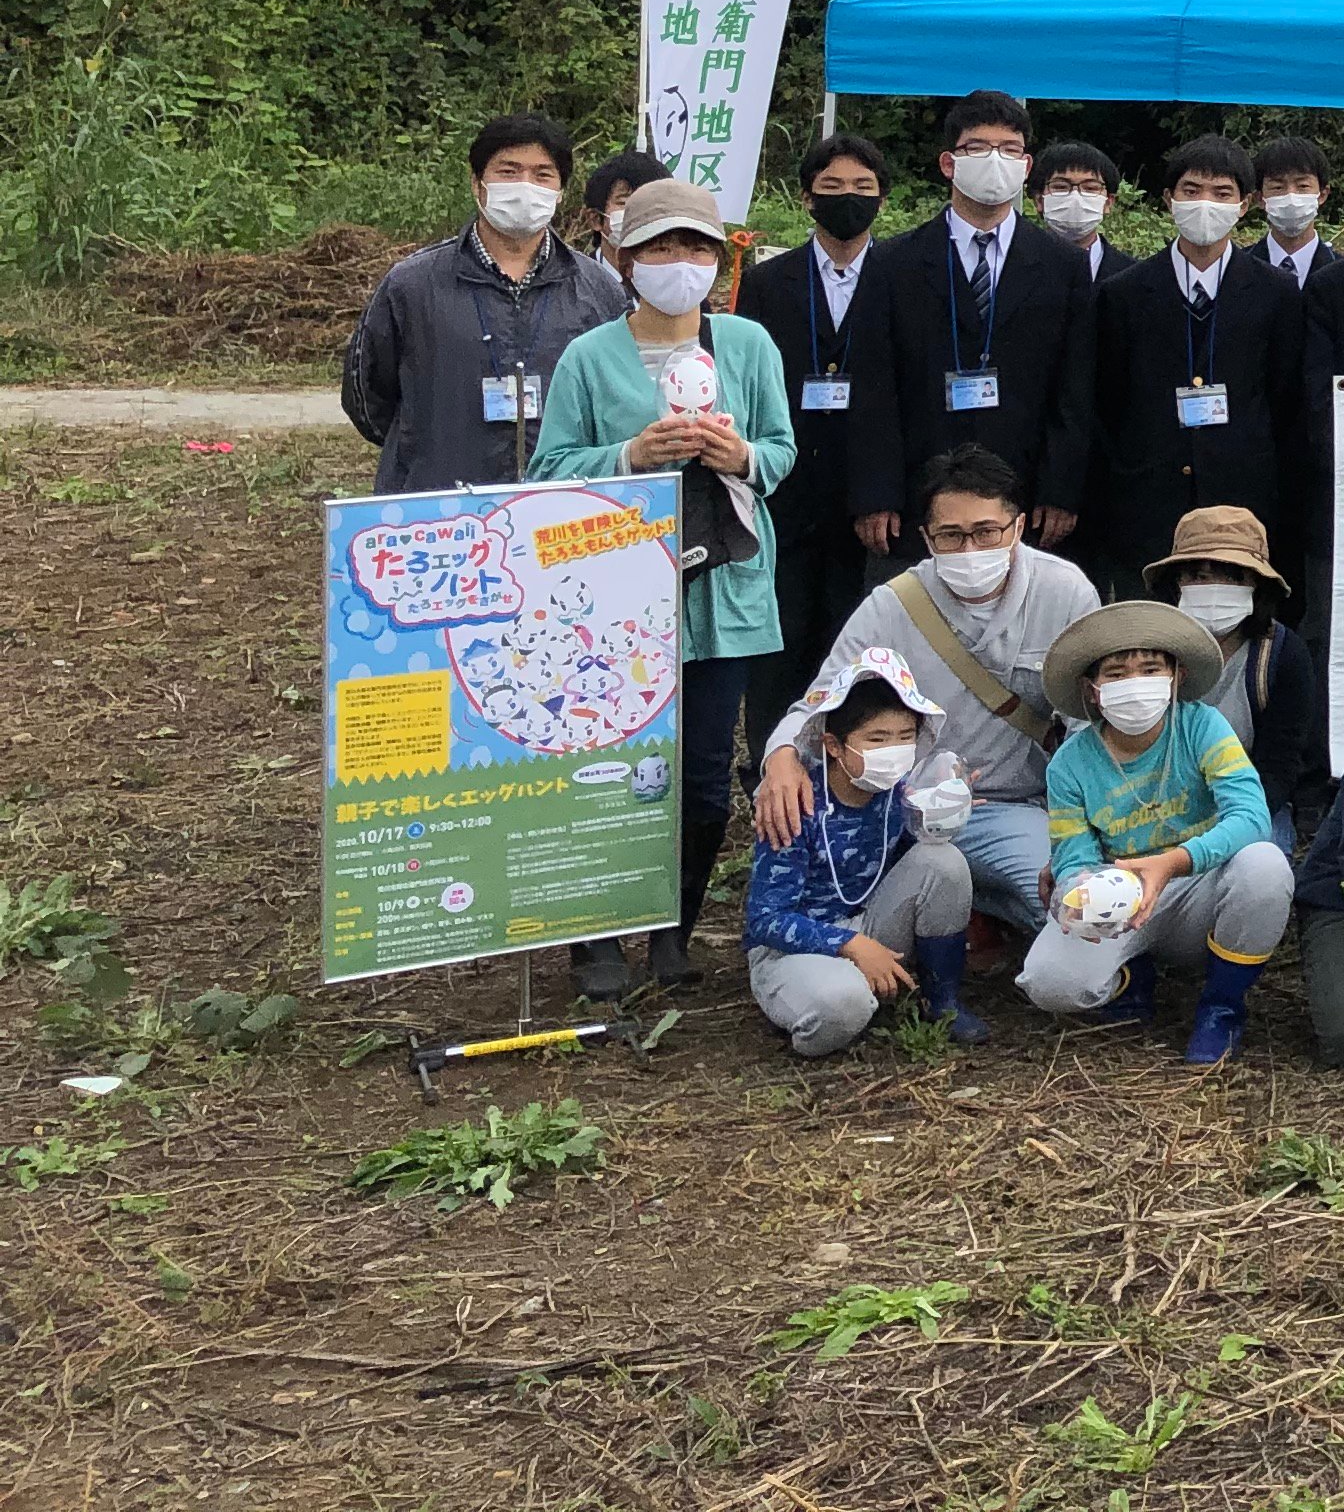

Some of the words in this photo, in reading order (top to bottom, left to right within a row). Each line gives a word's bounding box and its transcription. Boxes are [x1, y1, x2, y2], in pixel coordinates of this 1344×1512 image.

[371, 538, 493, 579] たろエッグ
[430, 569, 502, 596] ハント
[407, 591, 513, 614] たろエッグをさがせ
